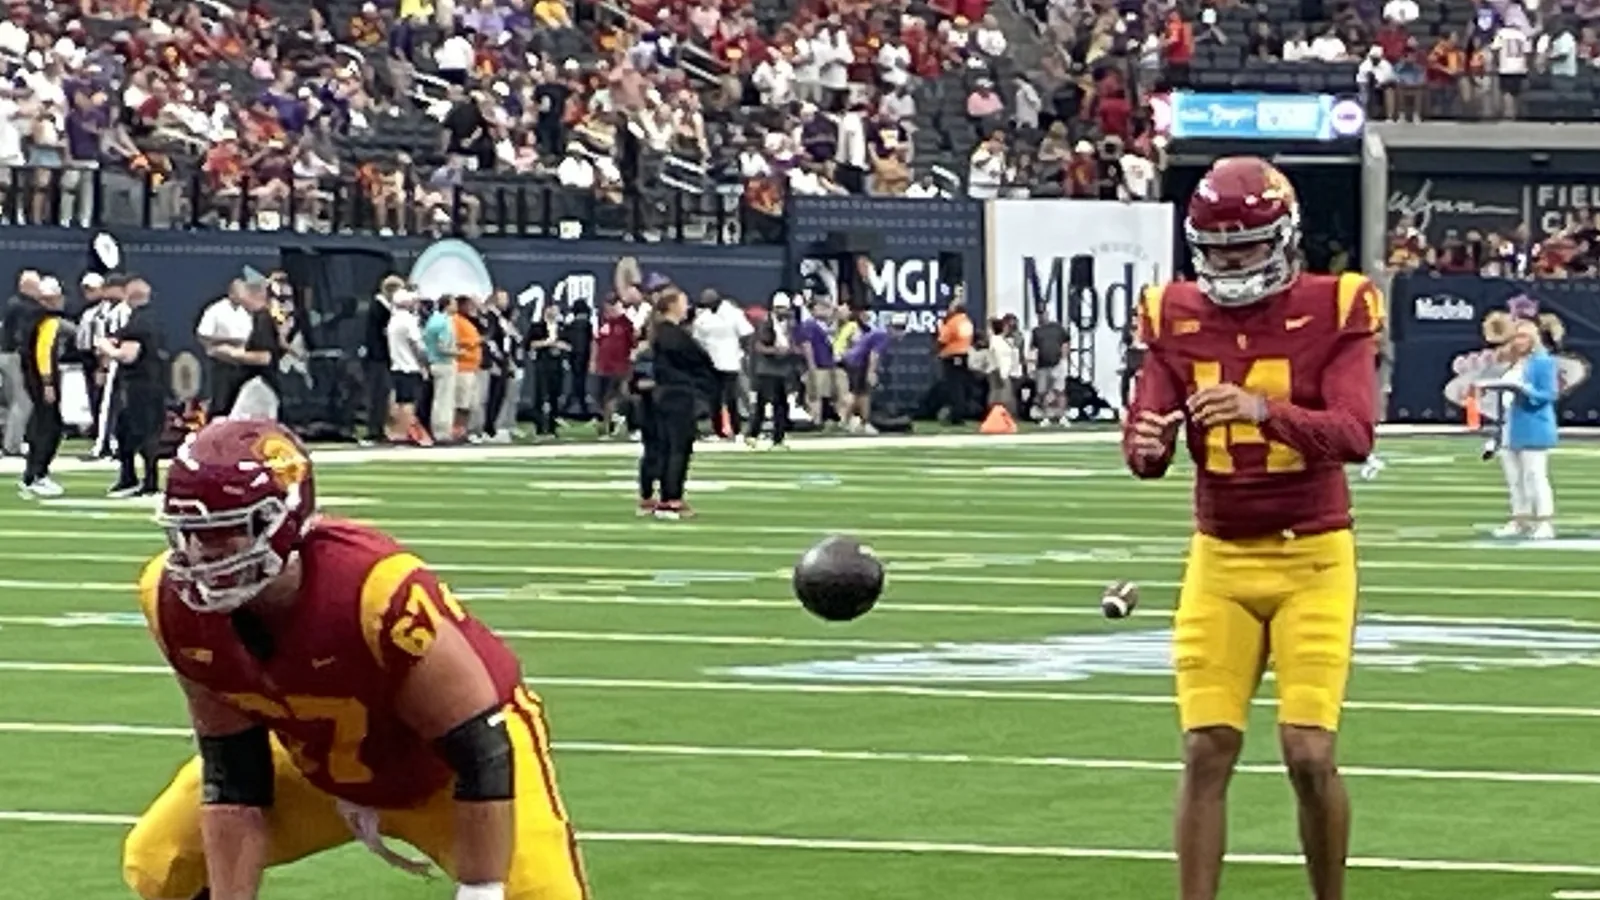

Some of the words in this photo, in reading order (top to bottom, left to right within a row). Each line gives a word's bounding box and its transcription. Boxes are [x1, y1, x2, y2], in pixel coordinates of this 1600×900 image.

[864, 258, 941, 305] MG
[1022, 254, 1159, 331] Mod
[1193, 358, 1306, 474] 14
